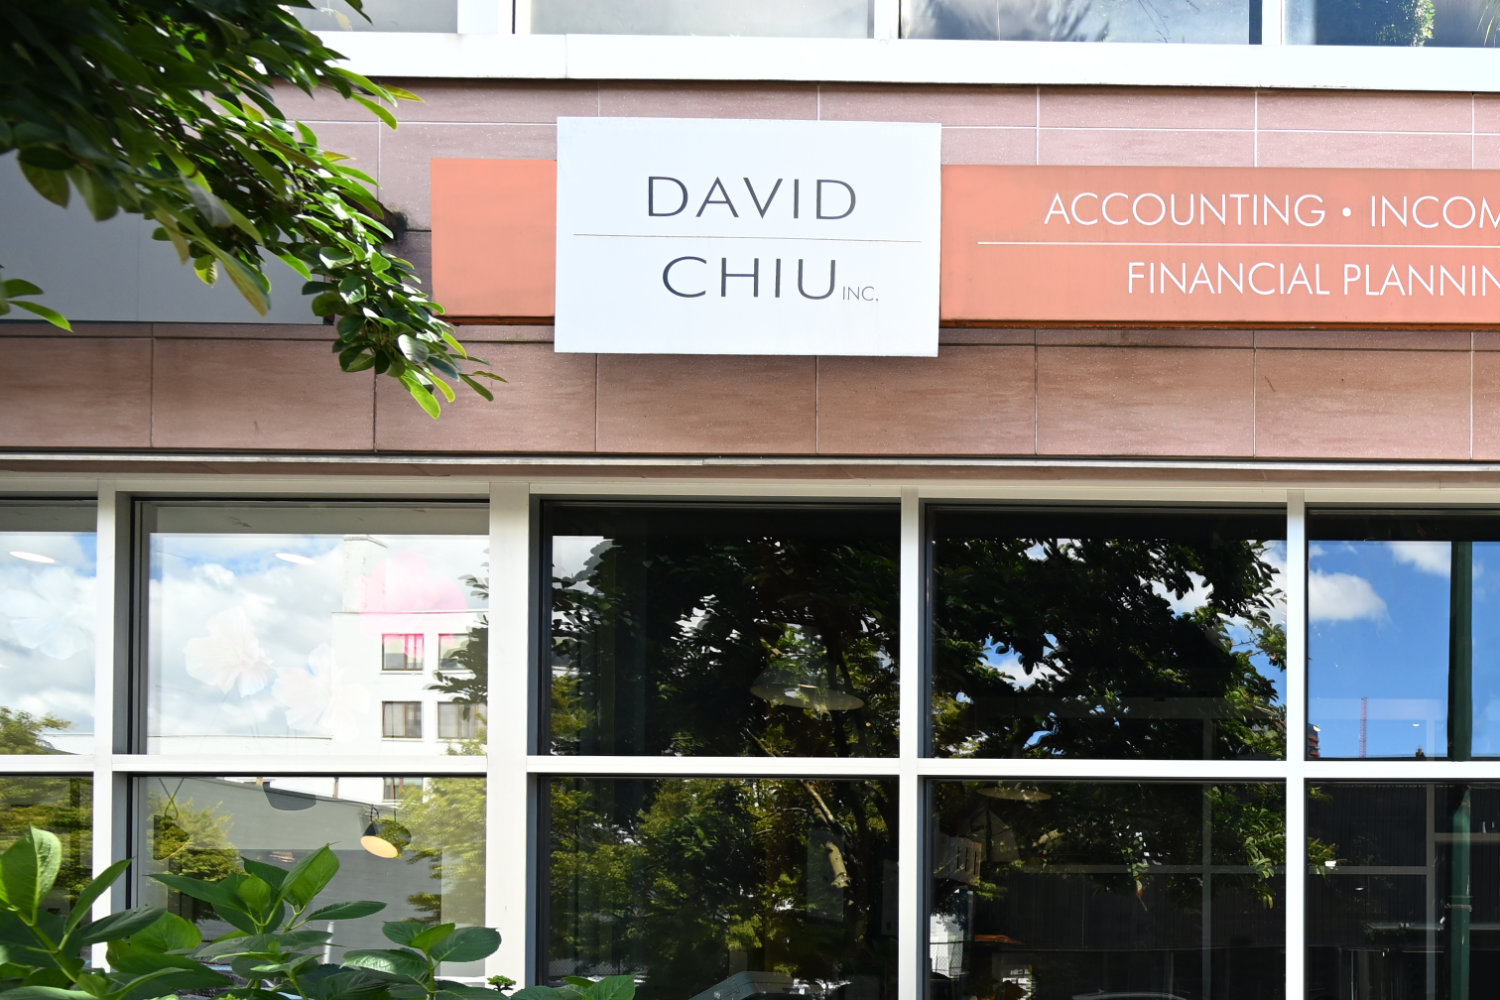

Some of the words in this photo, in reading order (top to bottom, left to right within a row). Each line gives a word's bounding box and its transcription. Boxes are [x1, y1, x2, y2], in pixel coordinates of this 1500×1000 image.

[647, 175, 857, 220] DAVID
[1043, 191, 1327, 228] ACCOUNTING
[662, 255, 837, 300] CHIU
[842, 285, 879, 302] INC.
[1127, 261, 1331, 296] FINANCIAL
